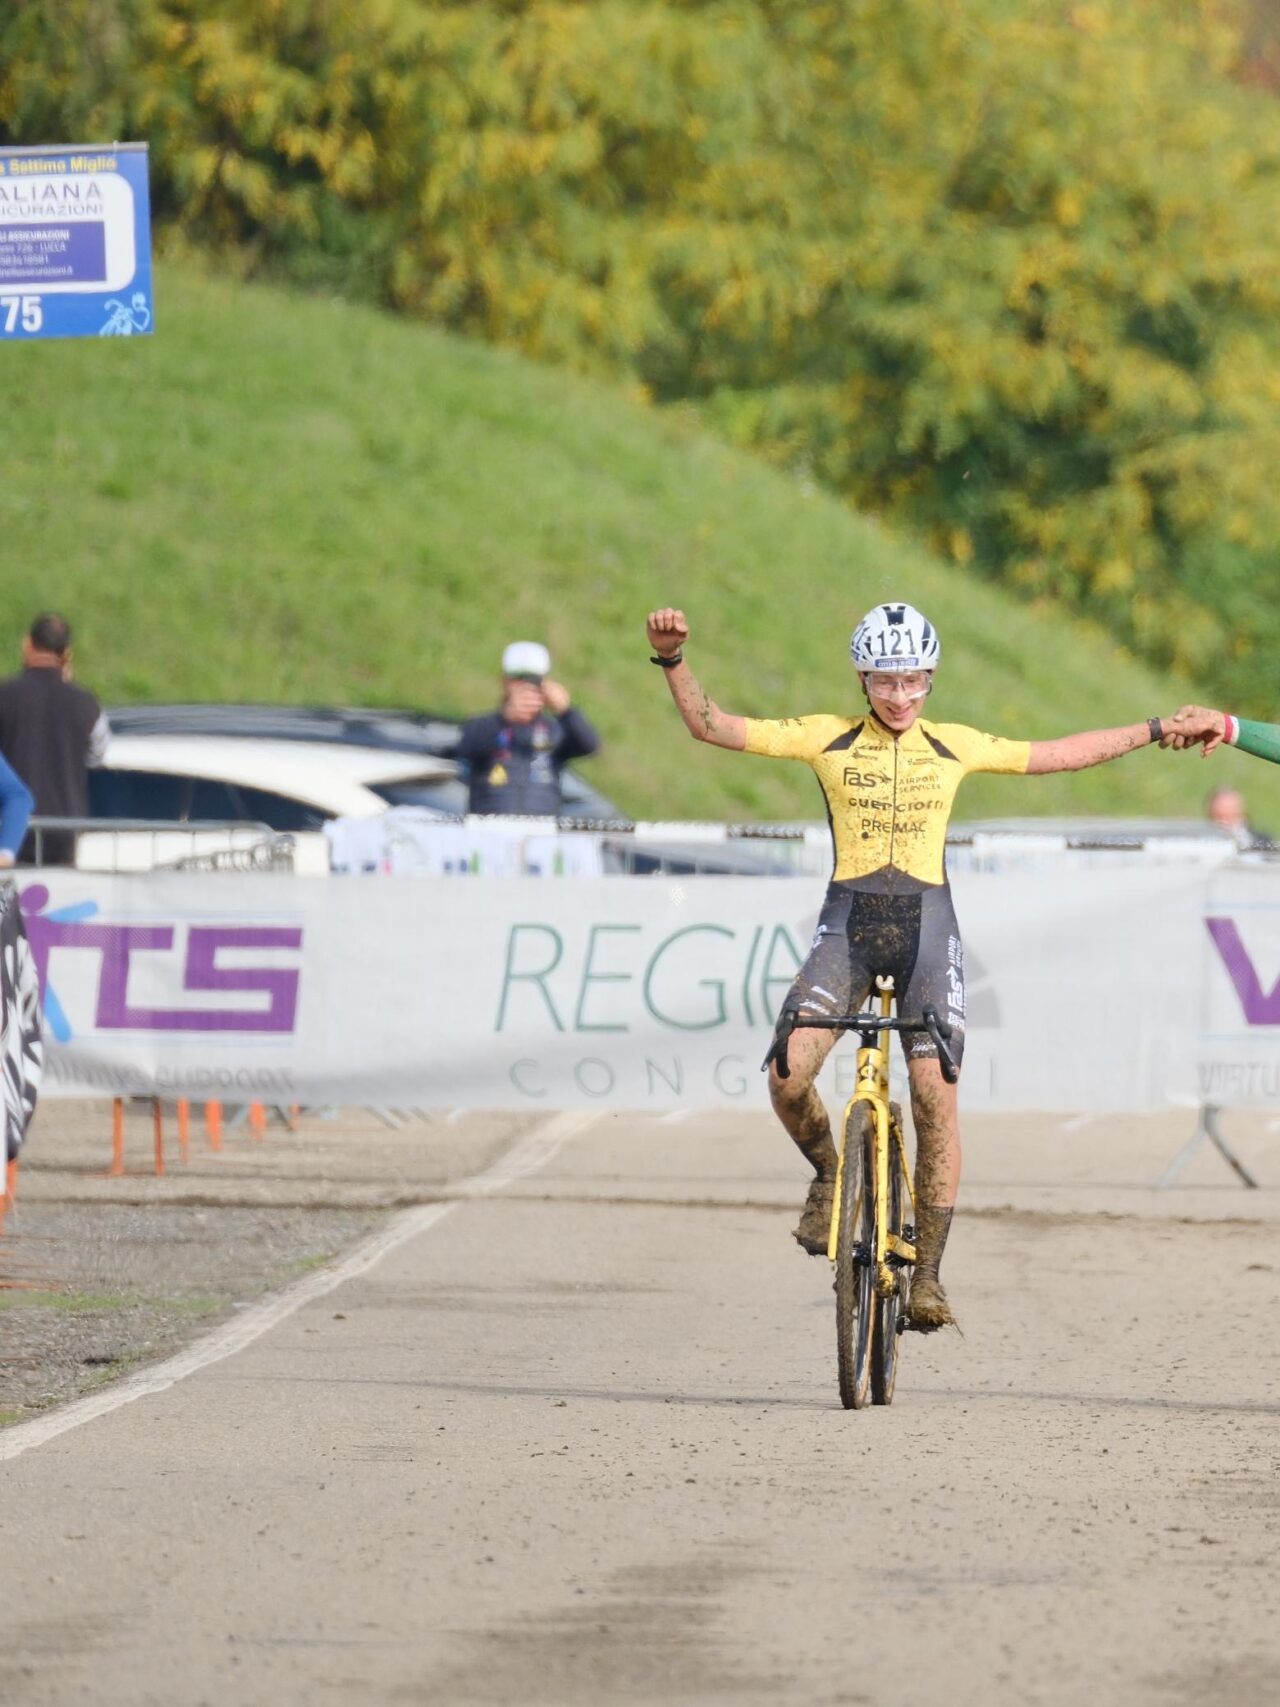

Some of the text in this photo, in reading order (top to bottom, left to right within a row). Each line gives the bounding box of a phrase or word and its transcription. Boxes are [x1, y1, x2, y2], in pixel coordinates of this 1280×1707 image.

[10, 158, 66, 176] Settimo
[70, 155, 117, 176] Miglio
[0, 295, 43, 332] 75
[877, 628, 916, 657] 121
[899, 774, 941, 786] AIRPORT
[861, 818, 928, 833] PREMAC
